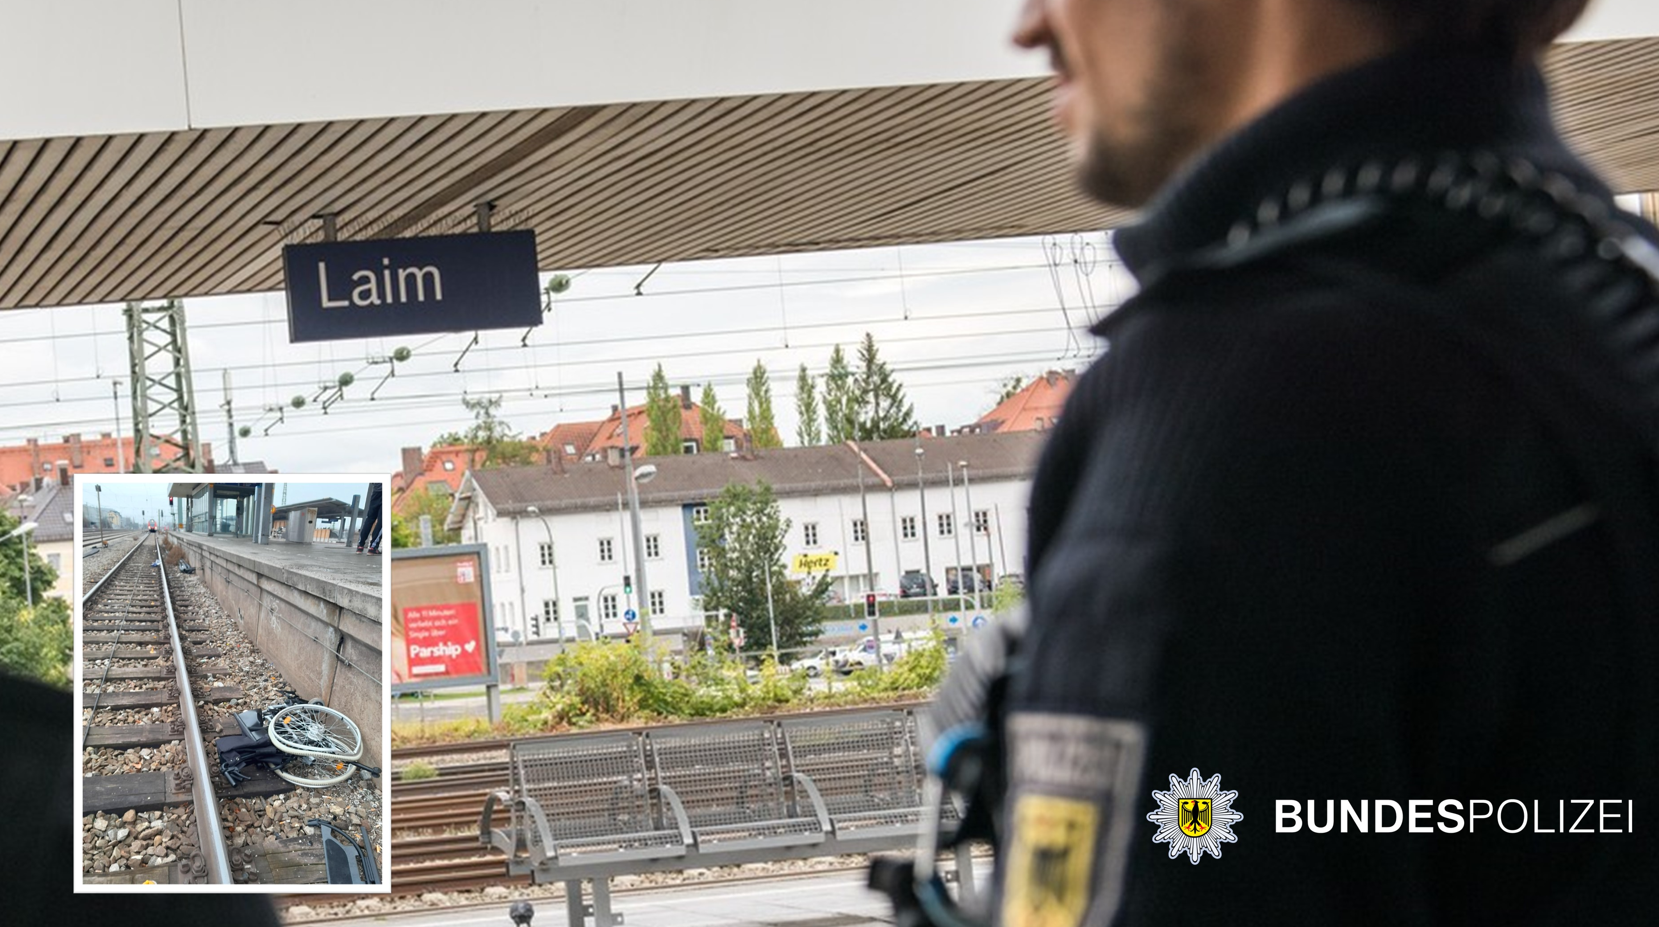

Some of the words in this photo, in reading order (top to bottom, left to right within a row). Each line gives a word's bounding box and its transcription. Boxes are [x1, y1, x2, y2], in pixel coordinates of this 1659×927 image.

[318, 257, 443, 309] Laim
[798, 557, 830, 569] Hertz
[410, 642, 462, 659] Parship
